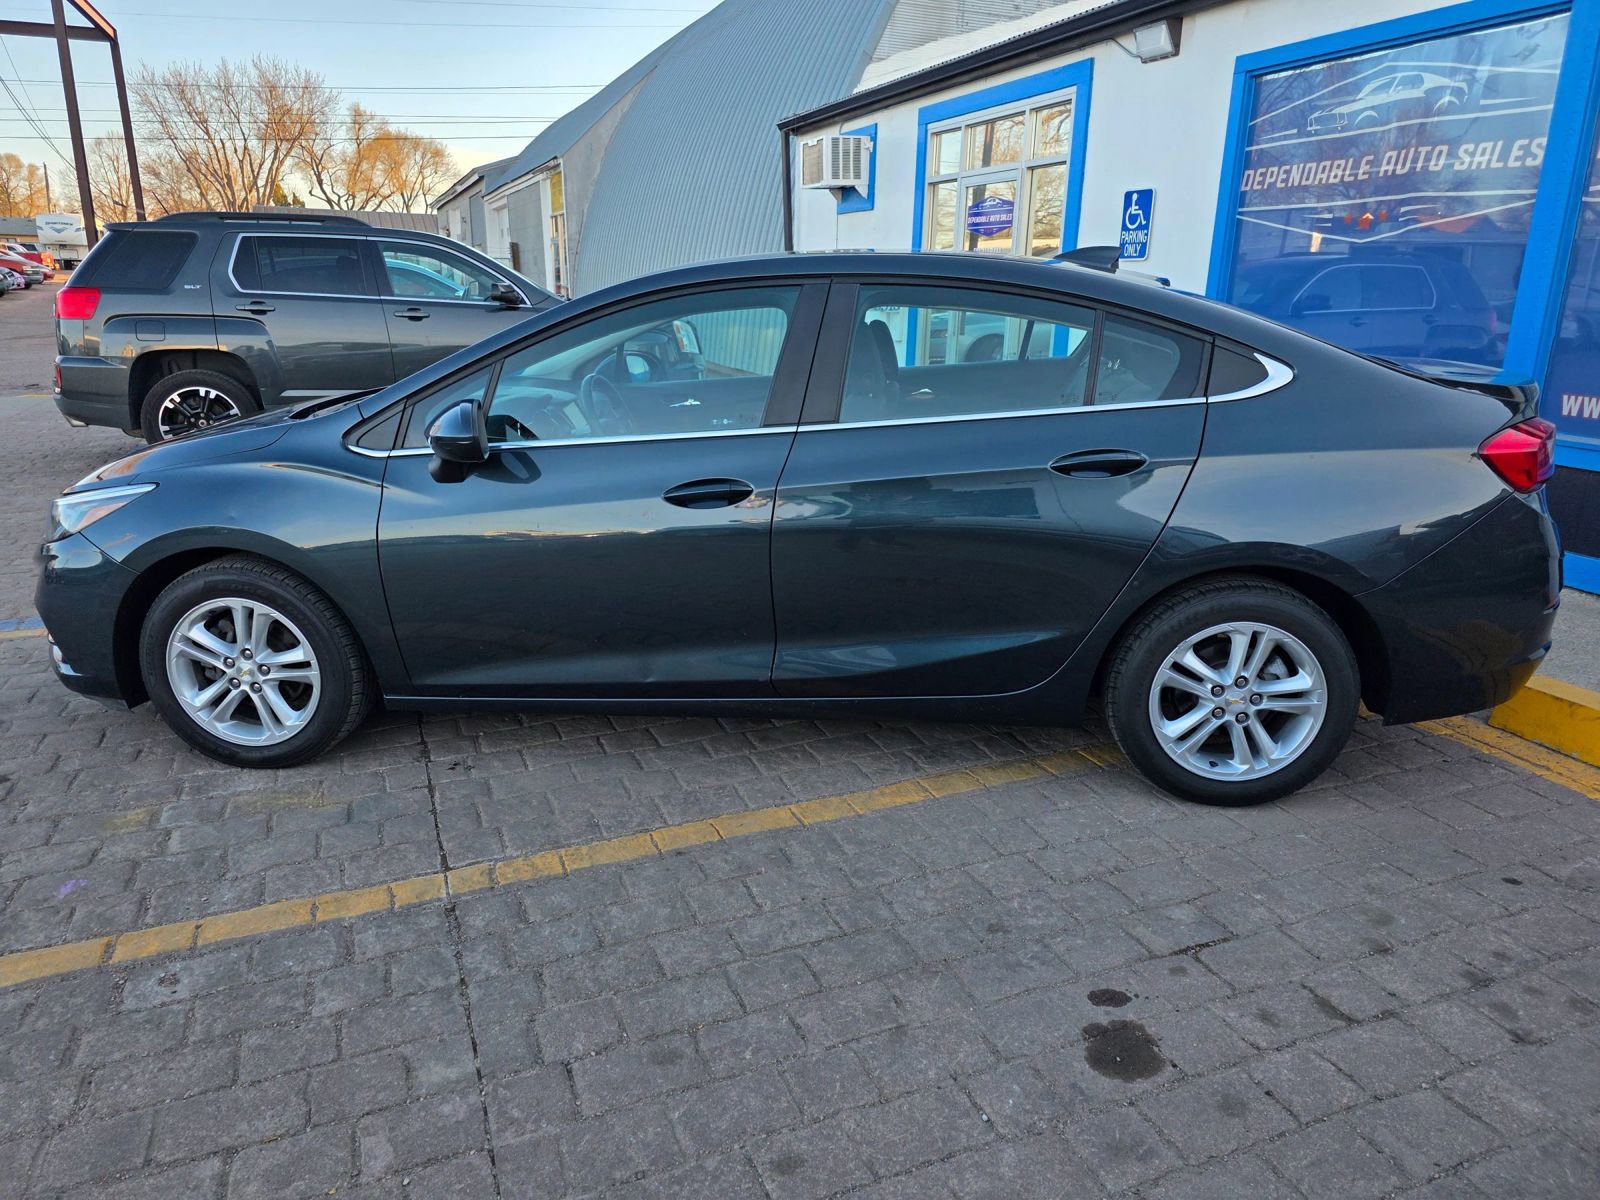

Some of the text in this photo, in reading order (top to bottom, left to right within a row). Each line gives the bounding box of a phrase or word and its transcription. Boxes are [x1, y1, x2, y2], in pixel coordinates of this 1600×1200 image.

[1240, 136, 1548, 192] DEPENDABLE AUTO SALES
[1121, 230, 1148, 244] PARKING
[1123, 243, 1142, 257] ONLY
